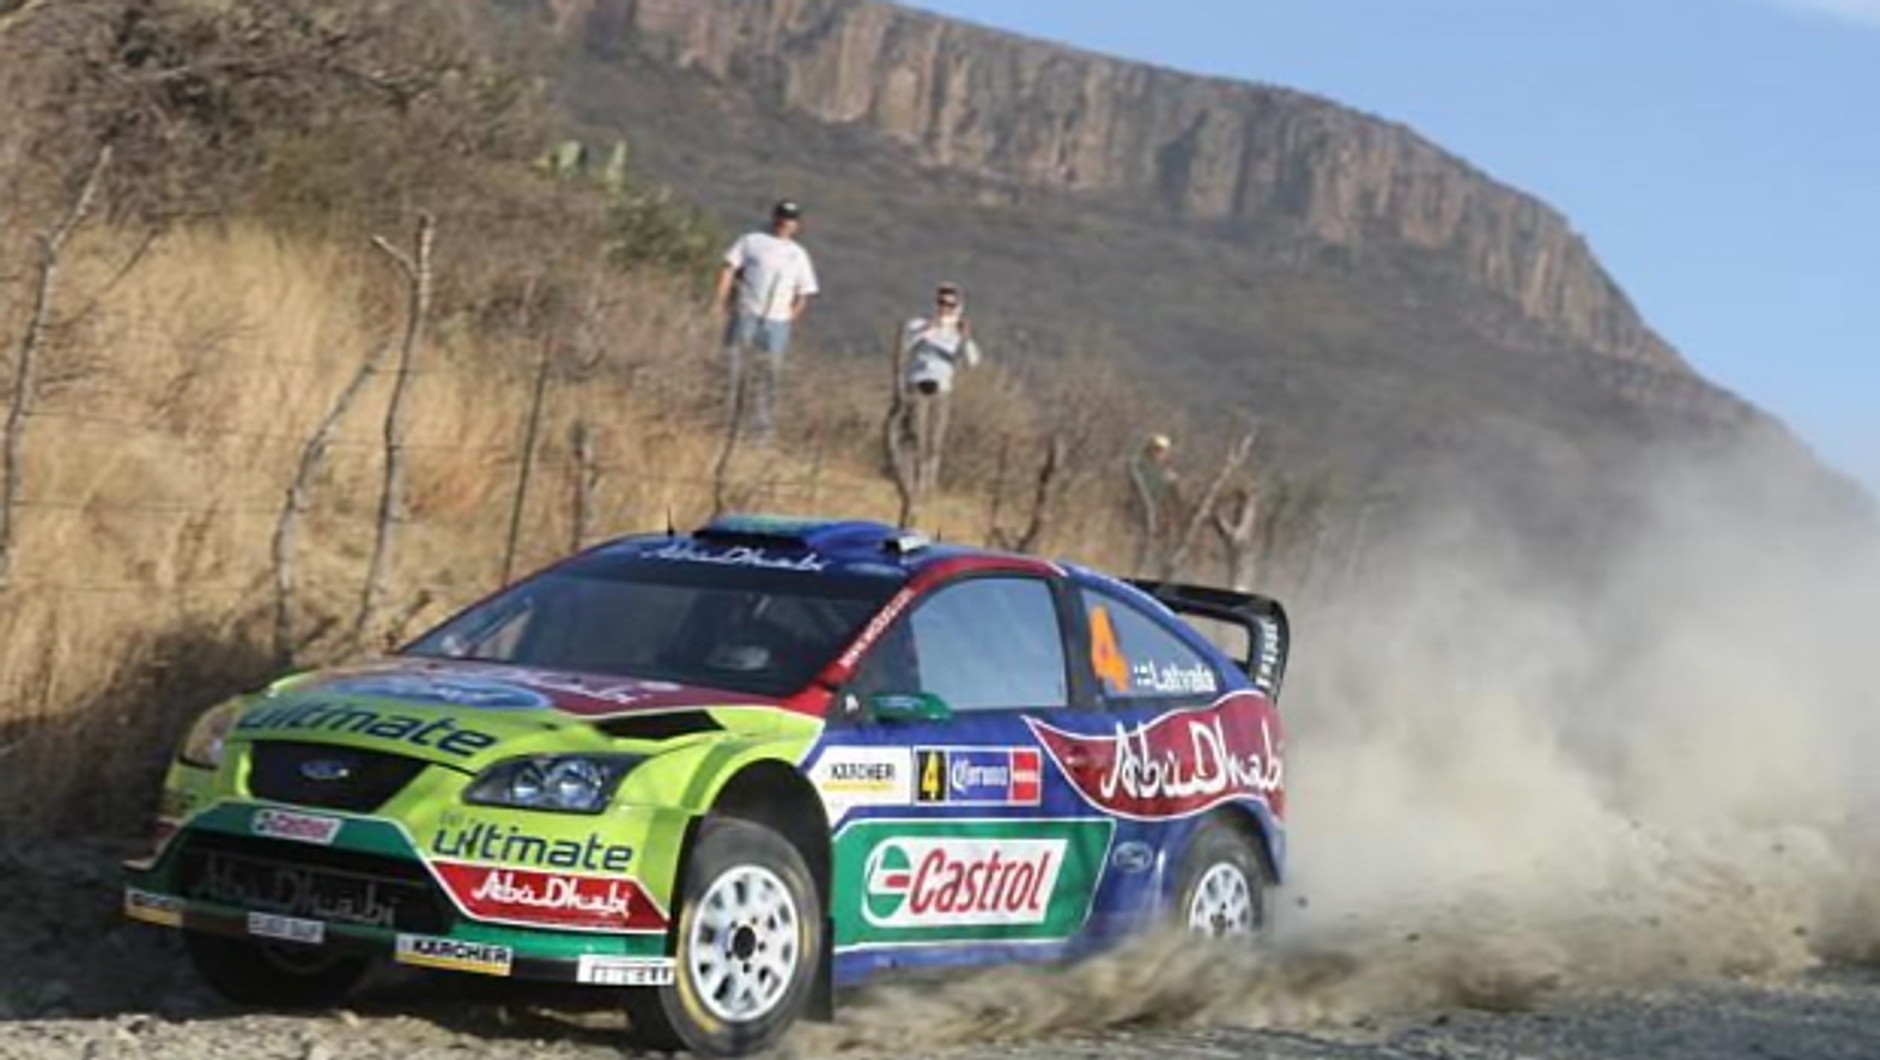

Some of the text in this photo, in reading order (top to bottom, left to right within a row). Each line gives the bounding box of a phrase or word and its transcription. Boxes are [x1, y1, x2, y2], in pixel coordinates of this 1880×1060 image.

[1089, 606, 1130, 692] 4
[1151, 660, 1217, 692] Latvala
[236, 702, 499, 757] ultimate
[921, 750, 940, 800] 4
[1100, 720, 1190, 798] Abu
[433, 822, 632, 871] ultimate
[472, 870, 632, 918] Abu Dhabi
[909, 848, 1051, 915] Castrol
